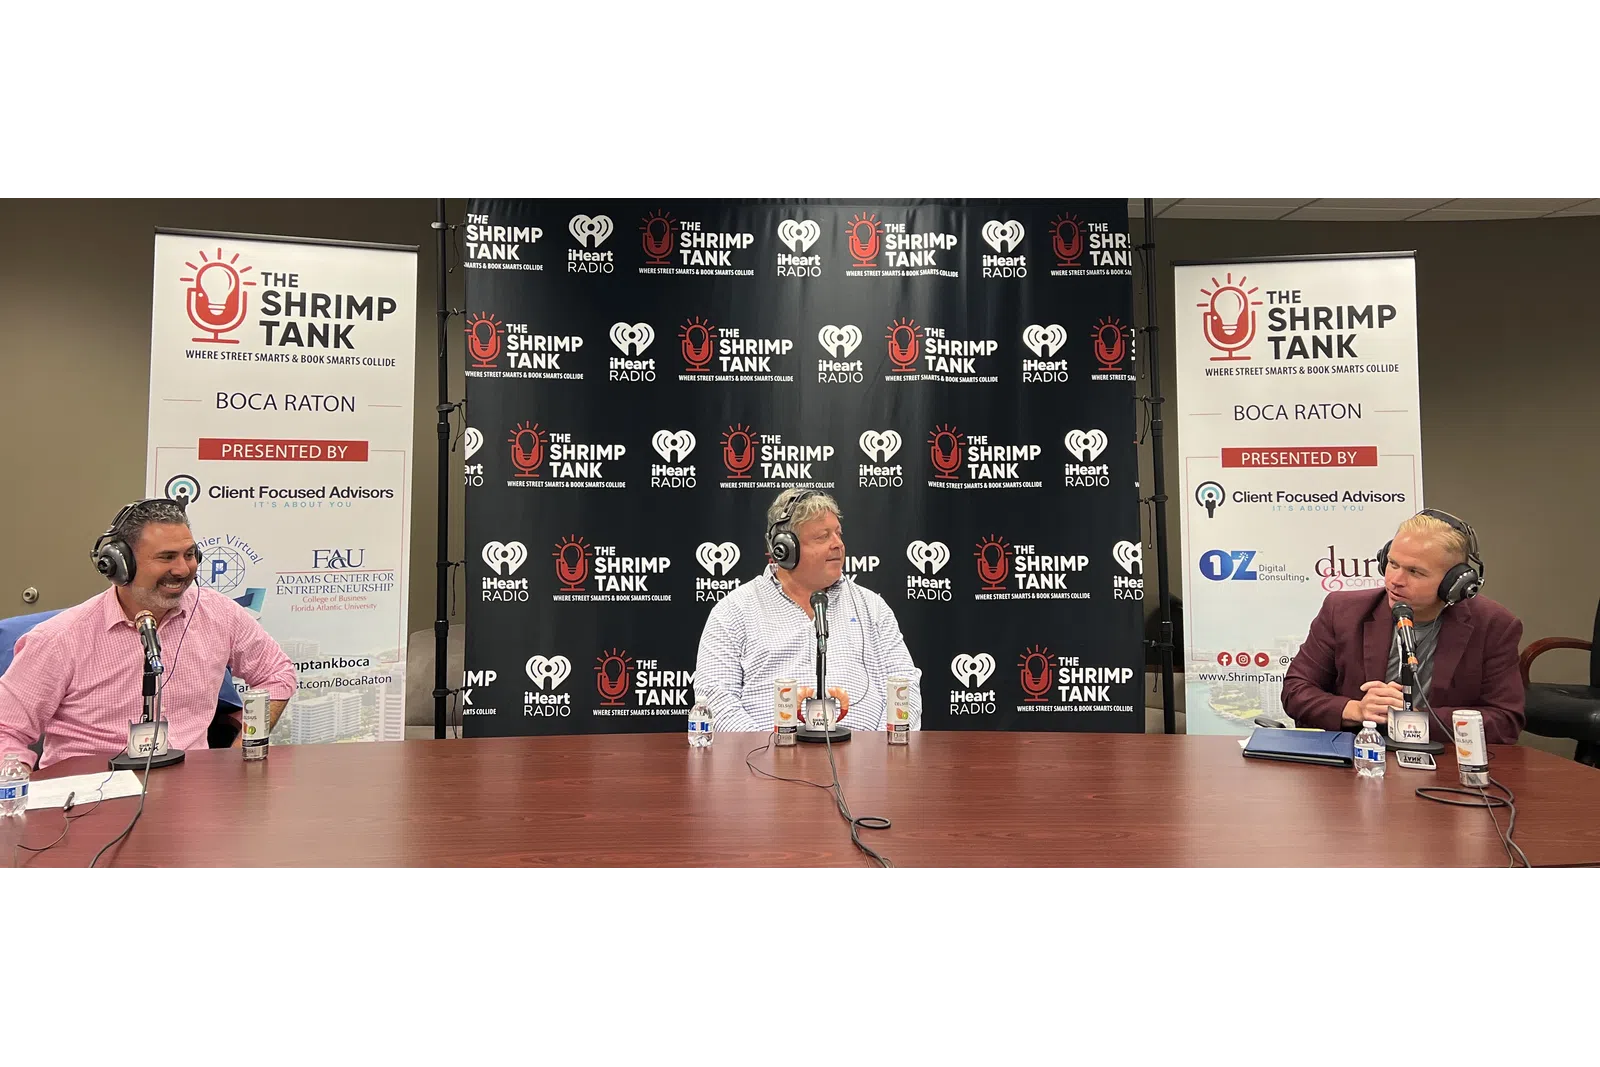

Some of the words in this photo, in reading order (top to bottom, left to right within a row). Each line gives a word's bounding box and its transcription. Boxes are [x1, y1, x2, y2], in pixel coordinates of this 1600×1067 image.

[467, 214, 488, 224] THE
[680, 222, 701, 231] THE
[884, 223, 906, 233] THE
[1088, 223, 1108, 232] THE
[466, 224, 543, 243] SHRIMP
[680, 232, 754, 249] SHRIMP
[885, 232, 957, 250] SHRIMP
[466, 242, 520, 260] TANK
[568, 249, 613, 262] iHeart
[680, 250, 731, 266] TANK
[777, 253, 821, 266] iHeart
[885, 250, 936, 267] TANK
[568, 262, 614, 273] RADIO
[778, 266, 821, 277] RADIO
[261, 272, 298, 288] THE
[1266, 290, 1301, 304] THE
[260, 290, 396, 321] SHRIMP
[1268, 305, 1396, 332] SHRIMP
[259, 320, 355, 349] TANK
[506, 324, 528, 333] THE
[718, 328, 740, 338] THE
[924, 328, 945, 338] THE
[507, 334, 583, 352] SHRIMP
[720, 339, 793, 355] SHRIMP
[925, 338, 998, 356] SHRIMP
[1268, 334, 1358, 360] TANK
[186, 350, 218, 360] WHERE
[221, 351, 253, 361] STREET
[255, 353, 290, 362] SMARTS
[292, 354, 298, 362] &
[301, 354, 325, 364] BOOK
[326, 356, 360, 365] SMARTS
[362, 357, 395, 367] COLLIDE
[506, 352, 560, 369] TANK
[610, 357, 655, 370] iHeart
[719, 356, 771, 372] TANK
[924, 355, 976, 373] TANK
[1023, 359, 1067, 371] iHeart
[610, 370, 656, 382] RADIO
[1023, 371, 1068, 382] RADIO
[1205, 368, 1233, 376] WHERE
[1235, 367, 1263, 376] STREET
[1265, 366, 1297, 375] SMARTS
[1299, 366, 1305, 374] &
[1307, 366, 1330, 374] BOOK
[1331, 364, 1364, 374] SMARTS
[1366, 364, 1398, 373] COLLIDE
[216, 392, 277, 410] BOCA
[285, 394, 354, 412] RATON
[1234, 404, 1288, 420] BOCA
[1295, 403, 1361, 420] RATON
[550, 433, 571, 443] THE
[760, 435, 781, 444] THE
[967, 436, 988, 445] THE
[222, 444, 321, 458] PRESENTED
[328, 446, 348, 458] BY
[550, 444, 626, 460] SHRIMP
[761, 445, 834, 461] SHRIMP
[968, 445, 1041, 462] SHRIMP
[1242, 452, 1332, 465] PRESENTED
[1338, 452, 1357, 464] BY
[549, 462, 602, 478] TANK
[652, 464, 696, 476] iHeart
[760, 463, 812, 478] TANK
[968, 463, 1019, 479] TANK
[1065, 464, 1108, 475] iHeart
[652, 477, 696, 488] RADIO
[1066, 476, 1110, 486] RADIO
[209, 486, 255, 498] Client
[259, 486, 325, 498] Focused
[329, 486, 394, 498] Advisors
[1232, 491, 1273, 502] Client
[1276, 491, 1338, 502] Focused
[1342, 490, 1405, 502] Advisors
[226, 534, 263, 564] Virtual
[594, 546, 616, 556] THE
[1014, 545, 1035, 554] THE
[312, 549, 365, 569] FAU
[595, 557, 670, 573] SHRIMP
[1015, 556, 1089, 572] SHRIMP
[1315, 545, 1377, 577] dur
[1259, 564, 1286, 574] Digital
[276, 575, 320, 584] ADAMS
[324, 574, 369, 583] CENTER
[372, 573, 394, 581] FOR
[482, 577, 528, 590] iHeart
[594, 575, 648, 591] TANK
[907, 575, 951, 589] iHeart
[1015, 574, 1067, 589] TANK
[1346, 578, 1385, 588] comp
[276, 583, 394, 594] ENTREPRENEURSHIP
[908, 588, 952, 601] RADIO
[482, 590, 529, 602] RADIO
[636, 660, 657, 670] THE
[1058, 657, 1079, 666] THE
[636, 670, 696, 688] SHRIM
[1058, 668, 1133, 684] SHRIMP
[524, 691, 570, 704] iHeart
[635, 689, 688, 706] TANK
[951, 690, 995, 702] iHeart
[1058, 686, 1110, 702] TANK
[524, 705, 570, 717] RADIO
[950, 702, 996, 715] RADIO
